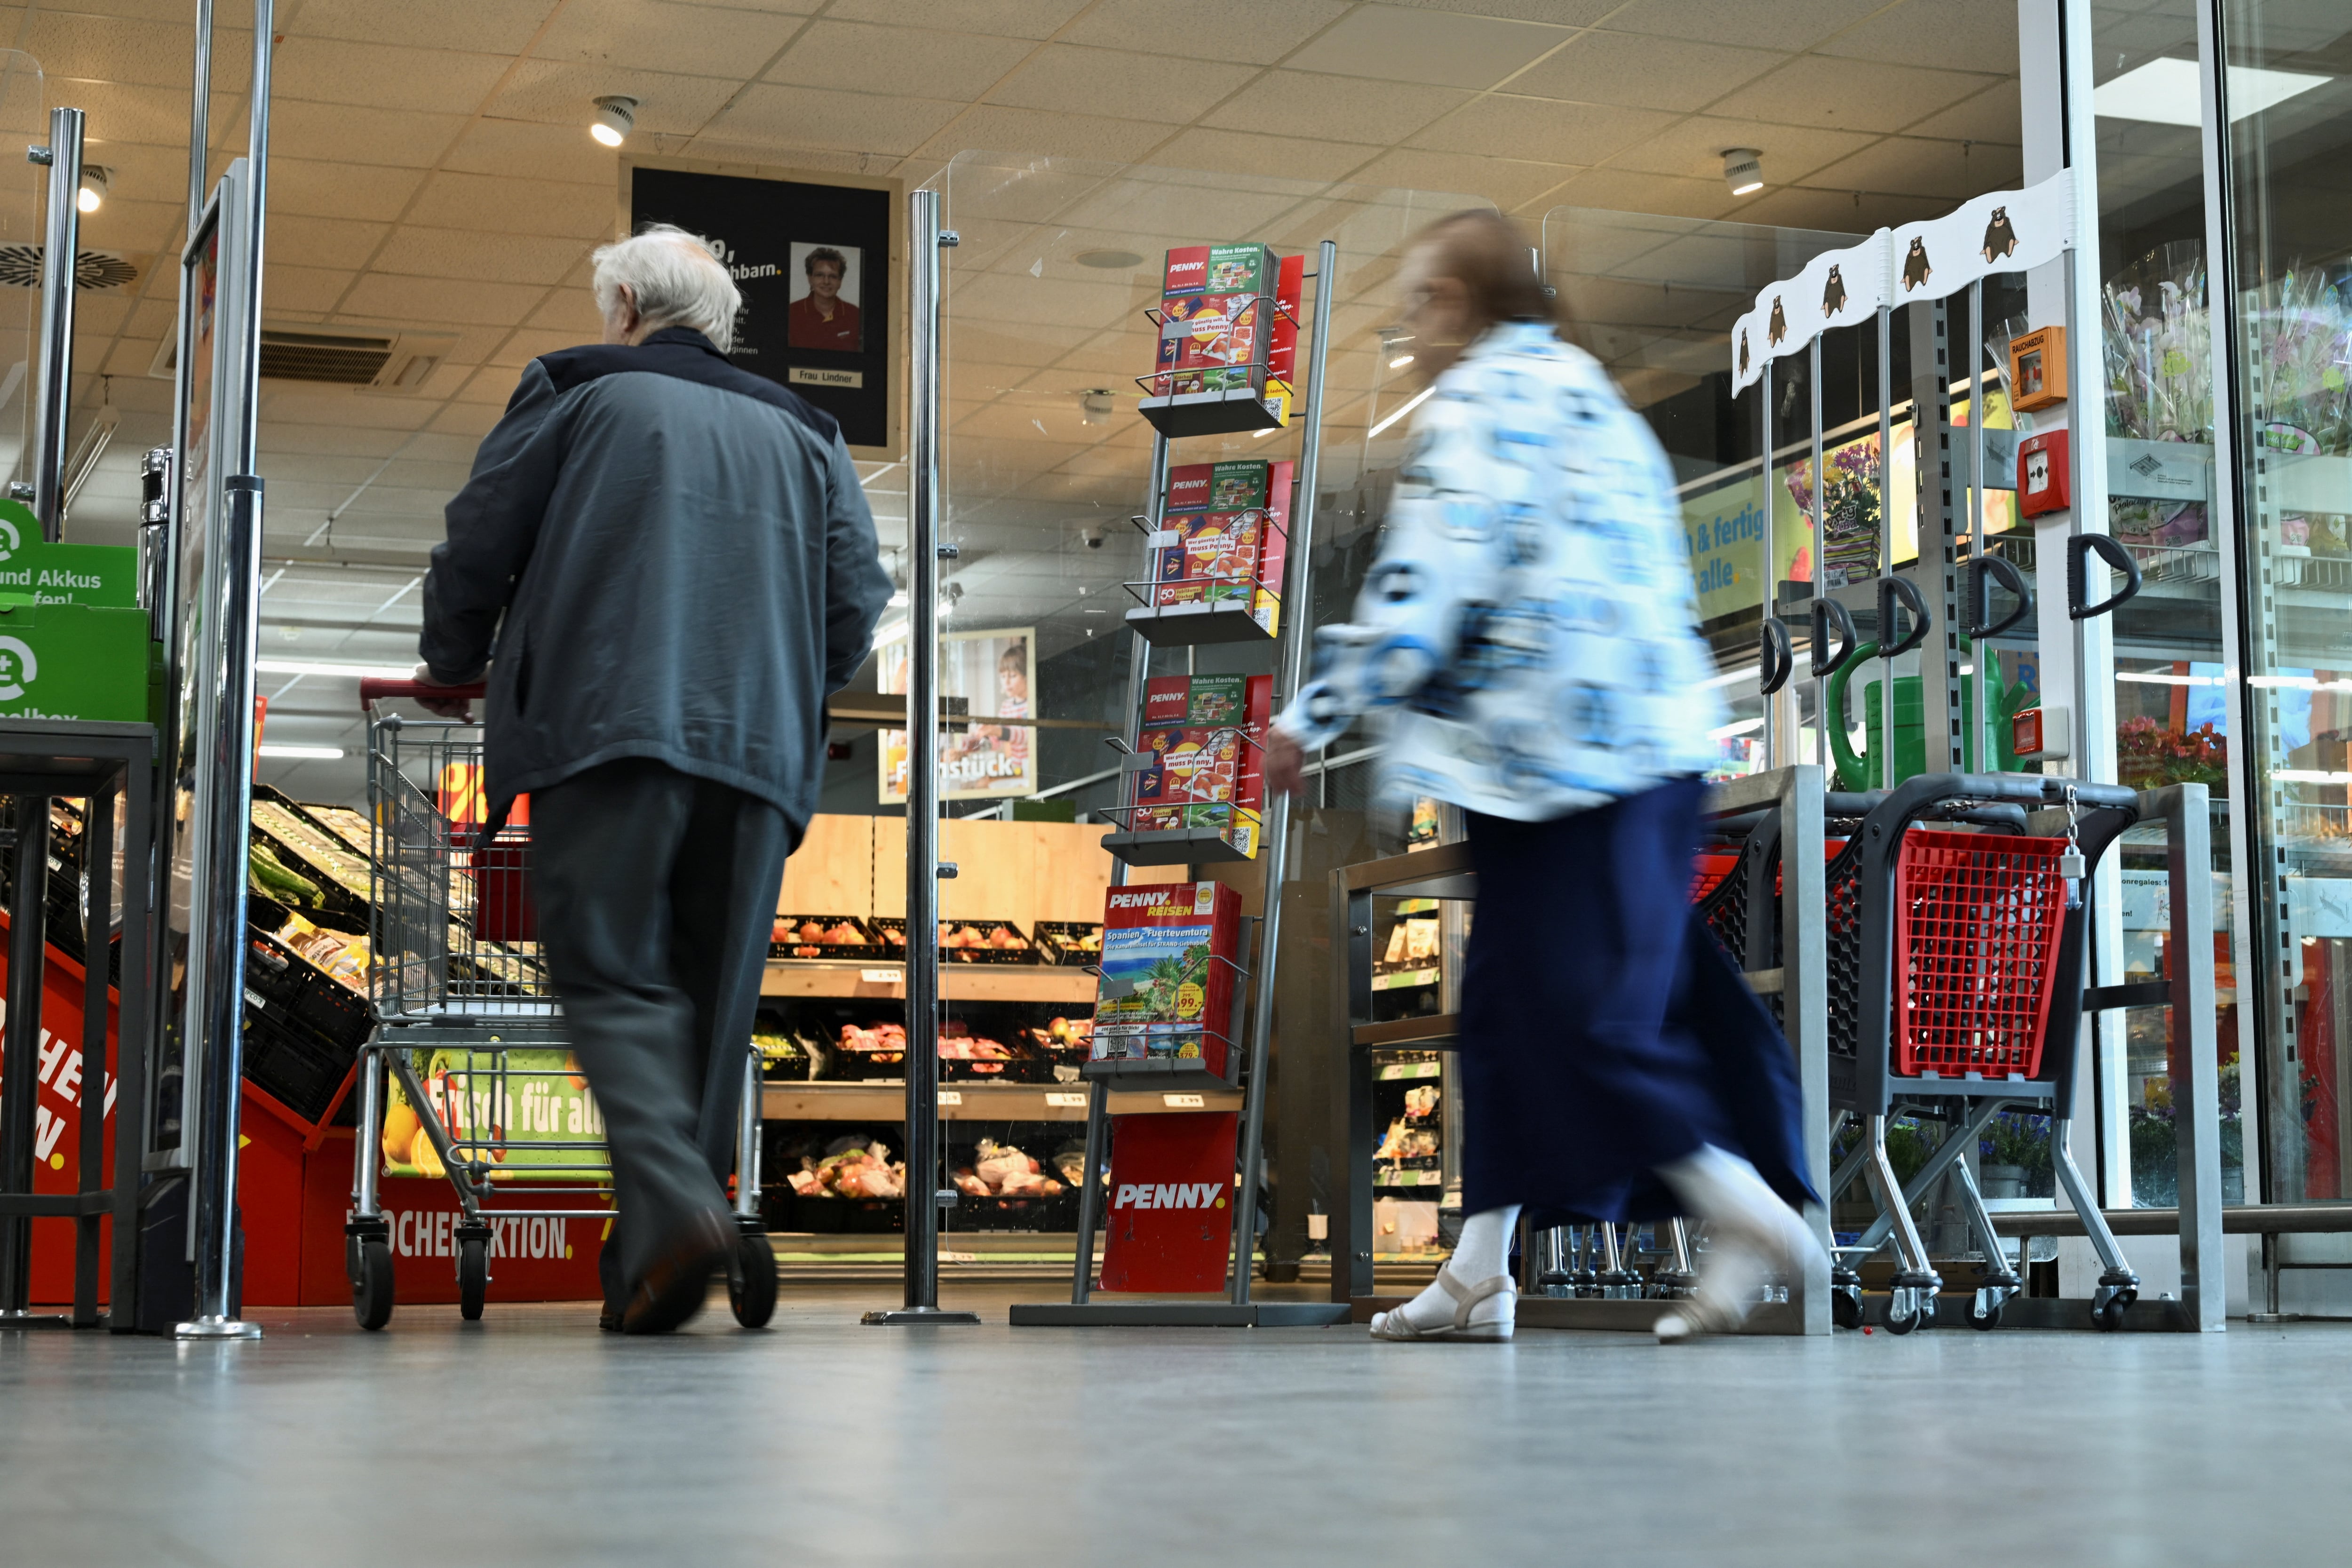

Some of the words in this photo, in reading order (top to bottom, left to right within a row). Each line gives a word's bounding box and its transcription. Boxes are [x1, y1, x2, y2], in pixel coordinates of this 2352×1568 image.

[730, 264, 781, 280] hbarn.
[1170, 262, 1205, 273] PENNY.
[2012, 335, 2043, 354] RAUCHABZUG
[800, 370, 818, 380] Frau
[823, 372, 852, 383] Lindner
[1173, 479, 1208, 490] PENNY.
[1698, 523, 1710, 553] &
[1714, 502, 1764, 548] fertig
[37, 570, 101, 589] Akkus
[1150, 692, 1185, 703] PENNY.
[1109, 892, 1171, 908] PENNY.
[1107, 930, 1139, 941] Spanien
[1148, 928, 1208, 938] Fuerteventura
[429, 1074, 513, 1130] Frisch
[521, 1081, 562, 1132] für
[568, 1086, 604, 1135] all
[1114, 1183, 1225, 1209] PENNY.
